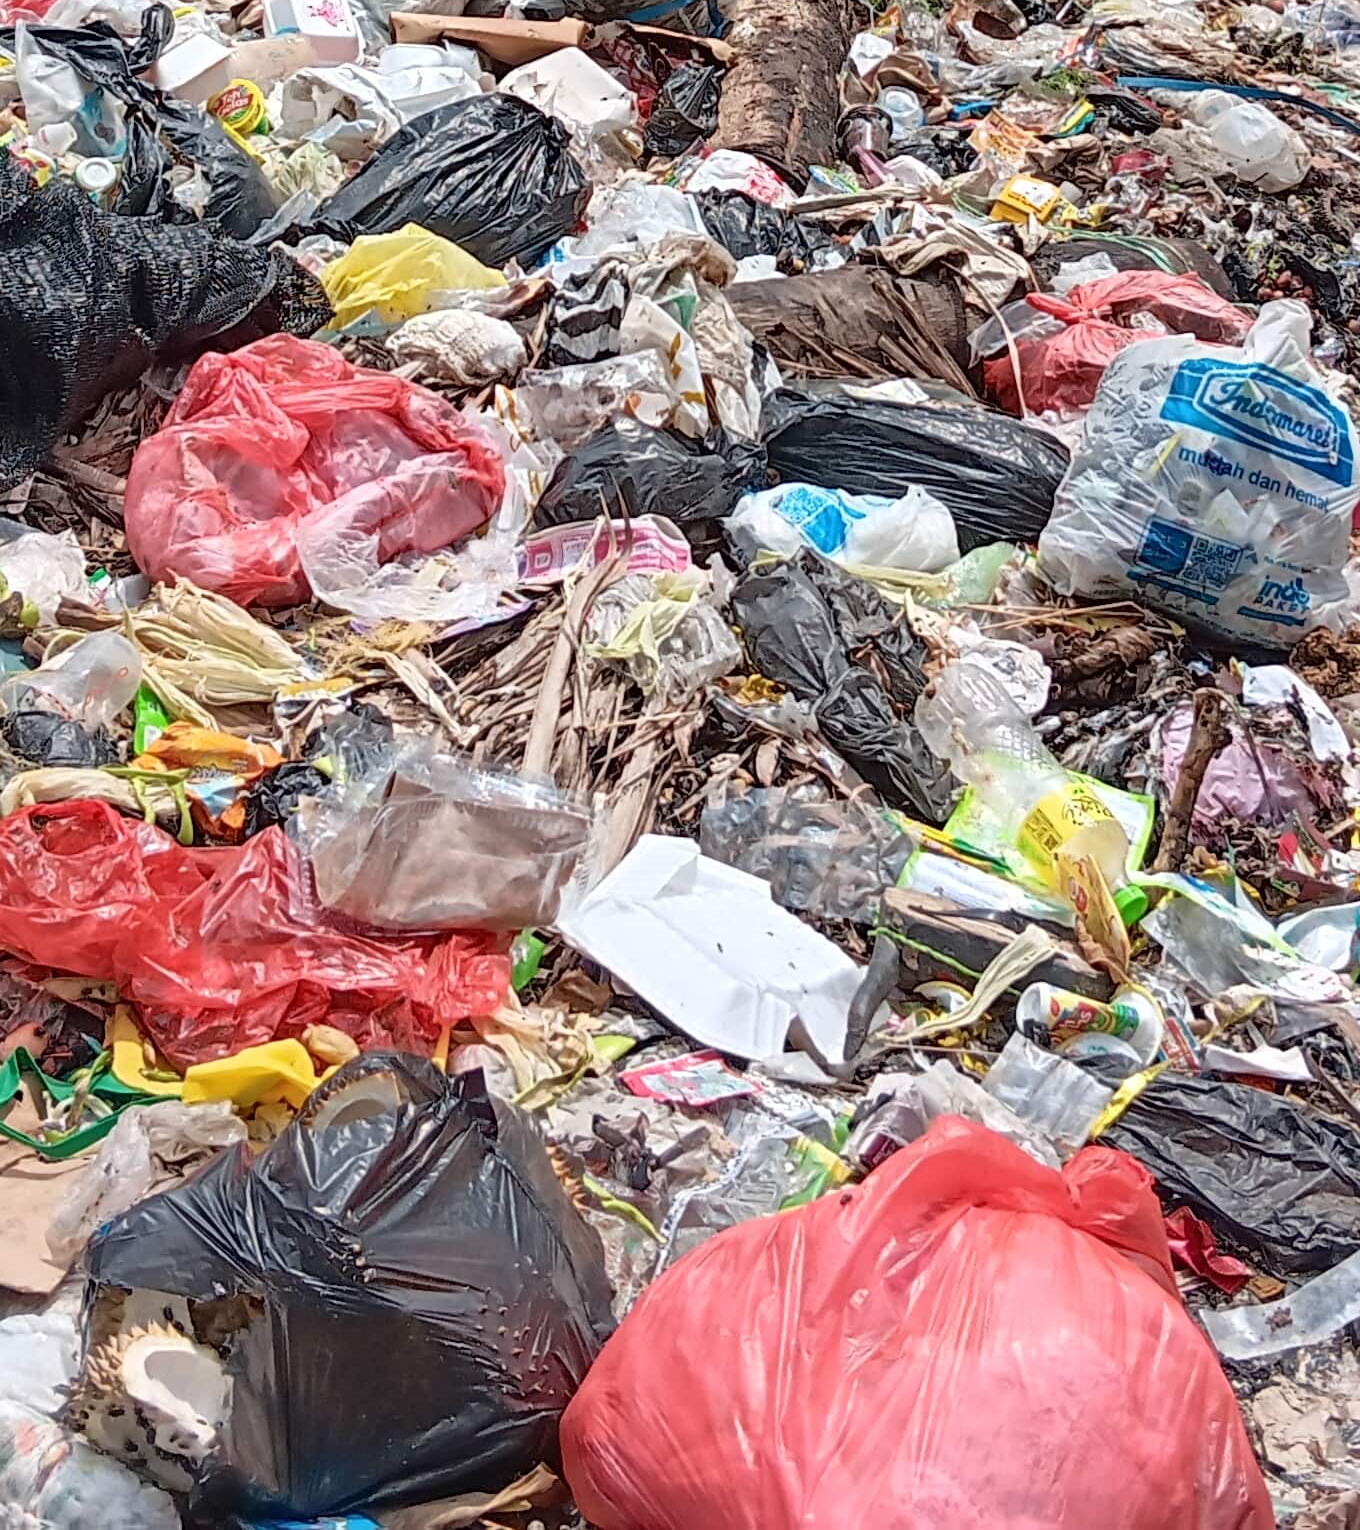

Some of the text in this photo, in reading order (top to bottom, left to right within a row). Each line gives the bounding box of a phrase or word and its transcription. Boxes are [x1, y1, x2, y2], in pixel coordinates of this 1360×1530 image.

[1248, 470, 1281, 494] dan
[1284, 482, 1330, 513] hemat
[1252, 596, 1311, 615] PAKET
